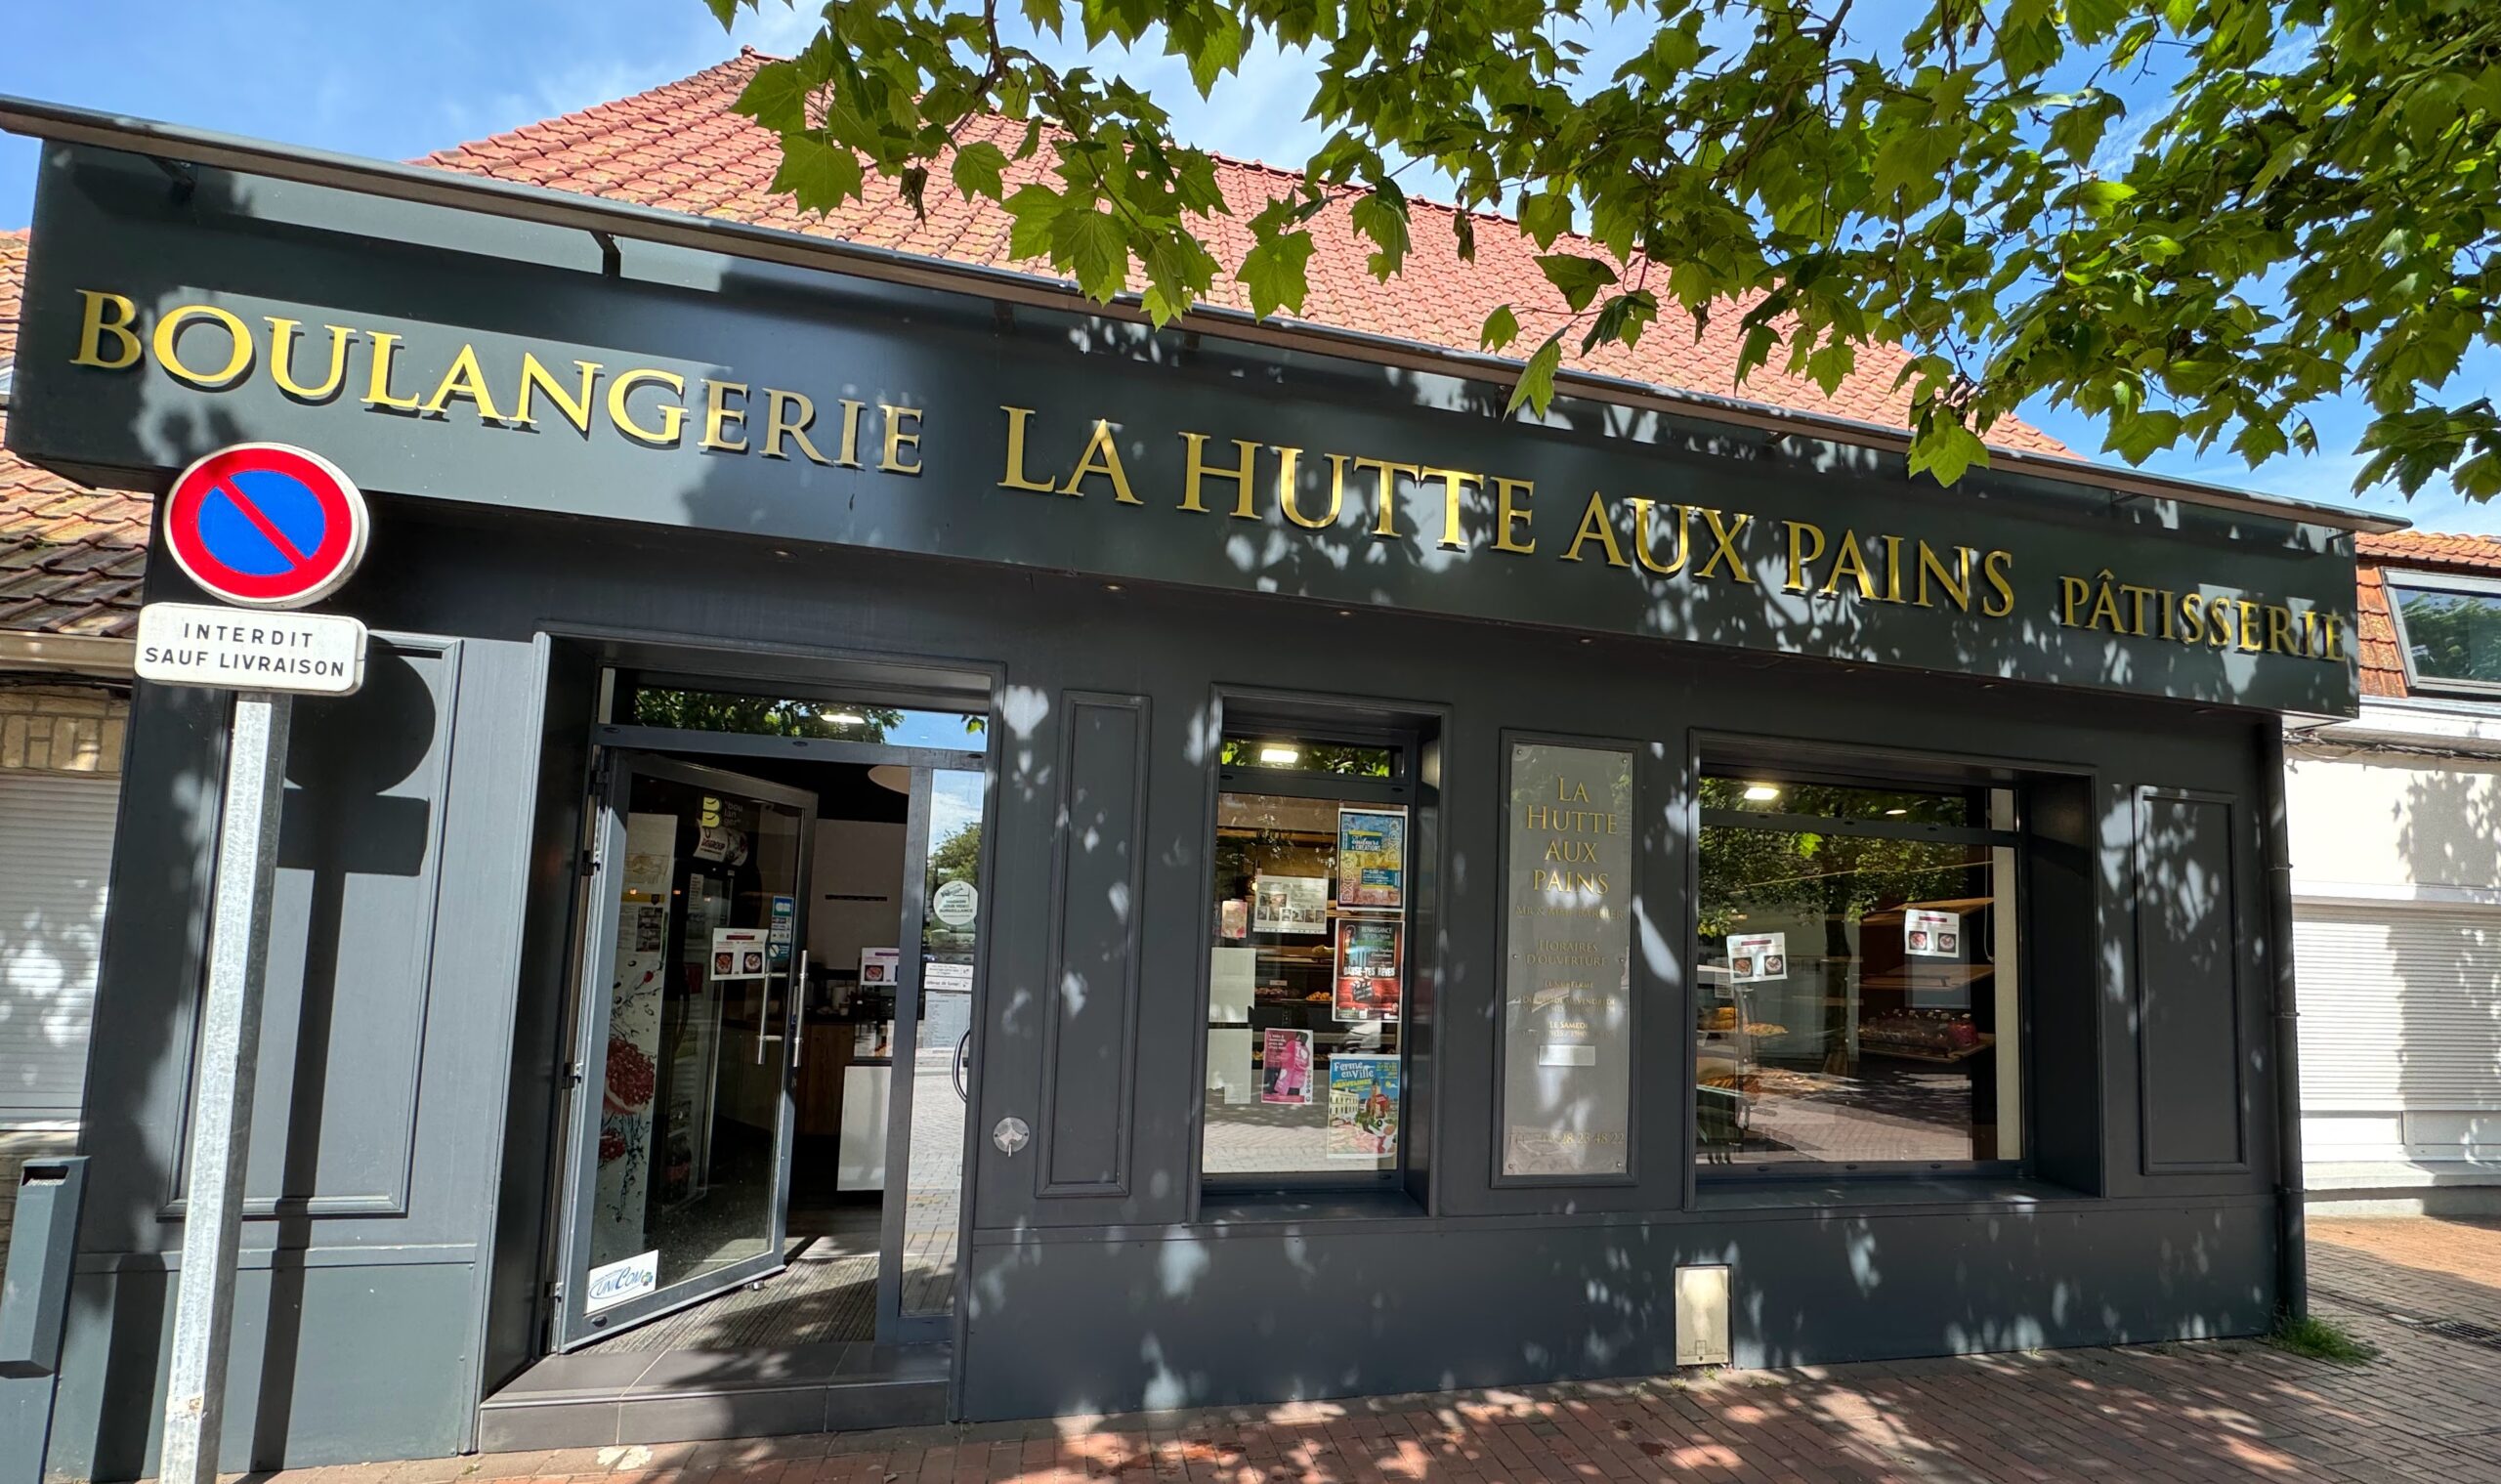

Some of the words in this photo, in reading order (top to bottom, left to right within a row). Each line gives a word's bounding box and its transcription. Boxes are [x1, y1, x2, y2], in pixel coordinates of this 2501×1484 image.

[69, 288, 924, 476] BOULANGERIE
[997, 404, 1144, 506] LA
[1176, 431, 1536, 555] HUTTE
[1560, 490, 1757, 585] AUX
[1781, 520, 2014, 617] PAINS
[2058, 569, 2347, 662] PÂTISSERIE
[184, 622, 314, 648] INTERDIT
[145, 647, 208, 667] SAUF
[220, 653, 344, 677] LIVRAISON
[1557, 776, 1590, 803] LA
[1526, 804, 1618, 835] HUTTE
[1545, 839, 1598, 864] AUX
[1533, 869, 1610, 896] PAINS
[1538, 938, 1599, 954] HORAIRES
[1525, 954, 1607, 968] D'OUVERTURE
